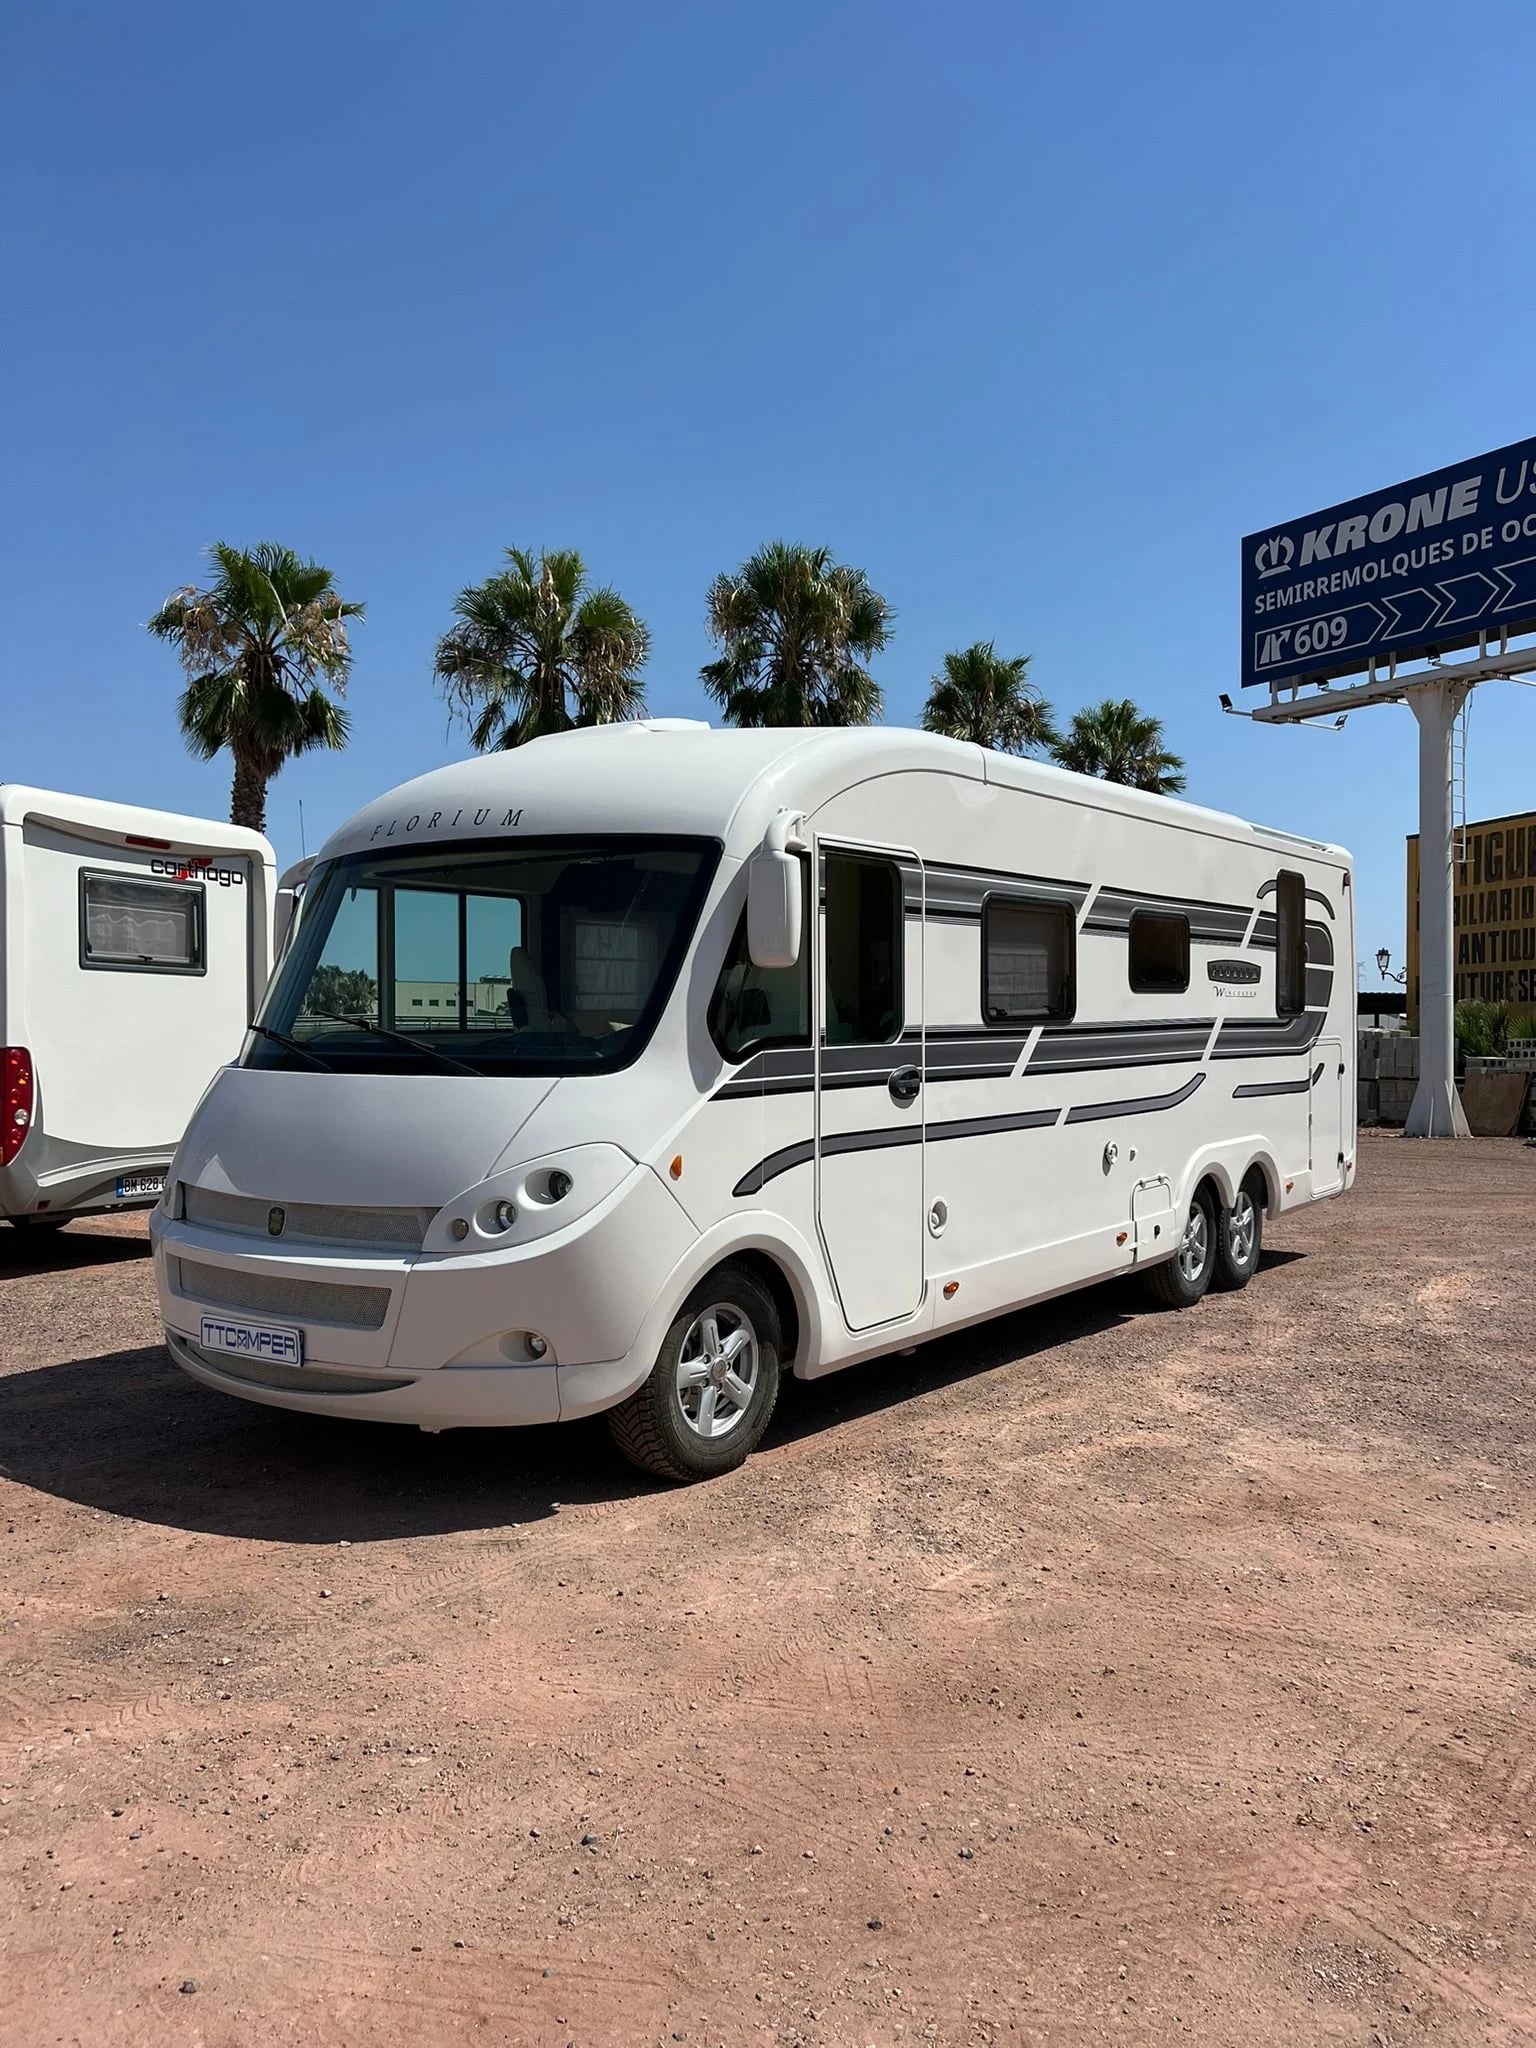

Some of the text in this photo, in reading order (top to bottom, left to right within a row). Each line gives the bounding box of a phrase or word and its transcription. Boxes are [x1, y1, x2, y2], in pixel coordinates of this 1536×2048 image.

[1300, 460, 1536, 567] KRONE U
[1254, 539, 1454, 615] SEMIRREMOLQUES
[1462, 526, 1493, 556] DE
[1294, 616, 1348, 655] 609
[370, 808, 524, 842] FLORIUM
[151, 858, 243, 887] carthago
[204, 1323, 296, 1357] TTCAMPER
